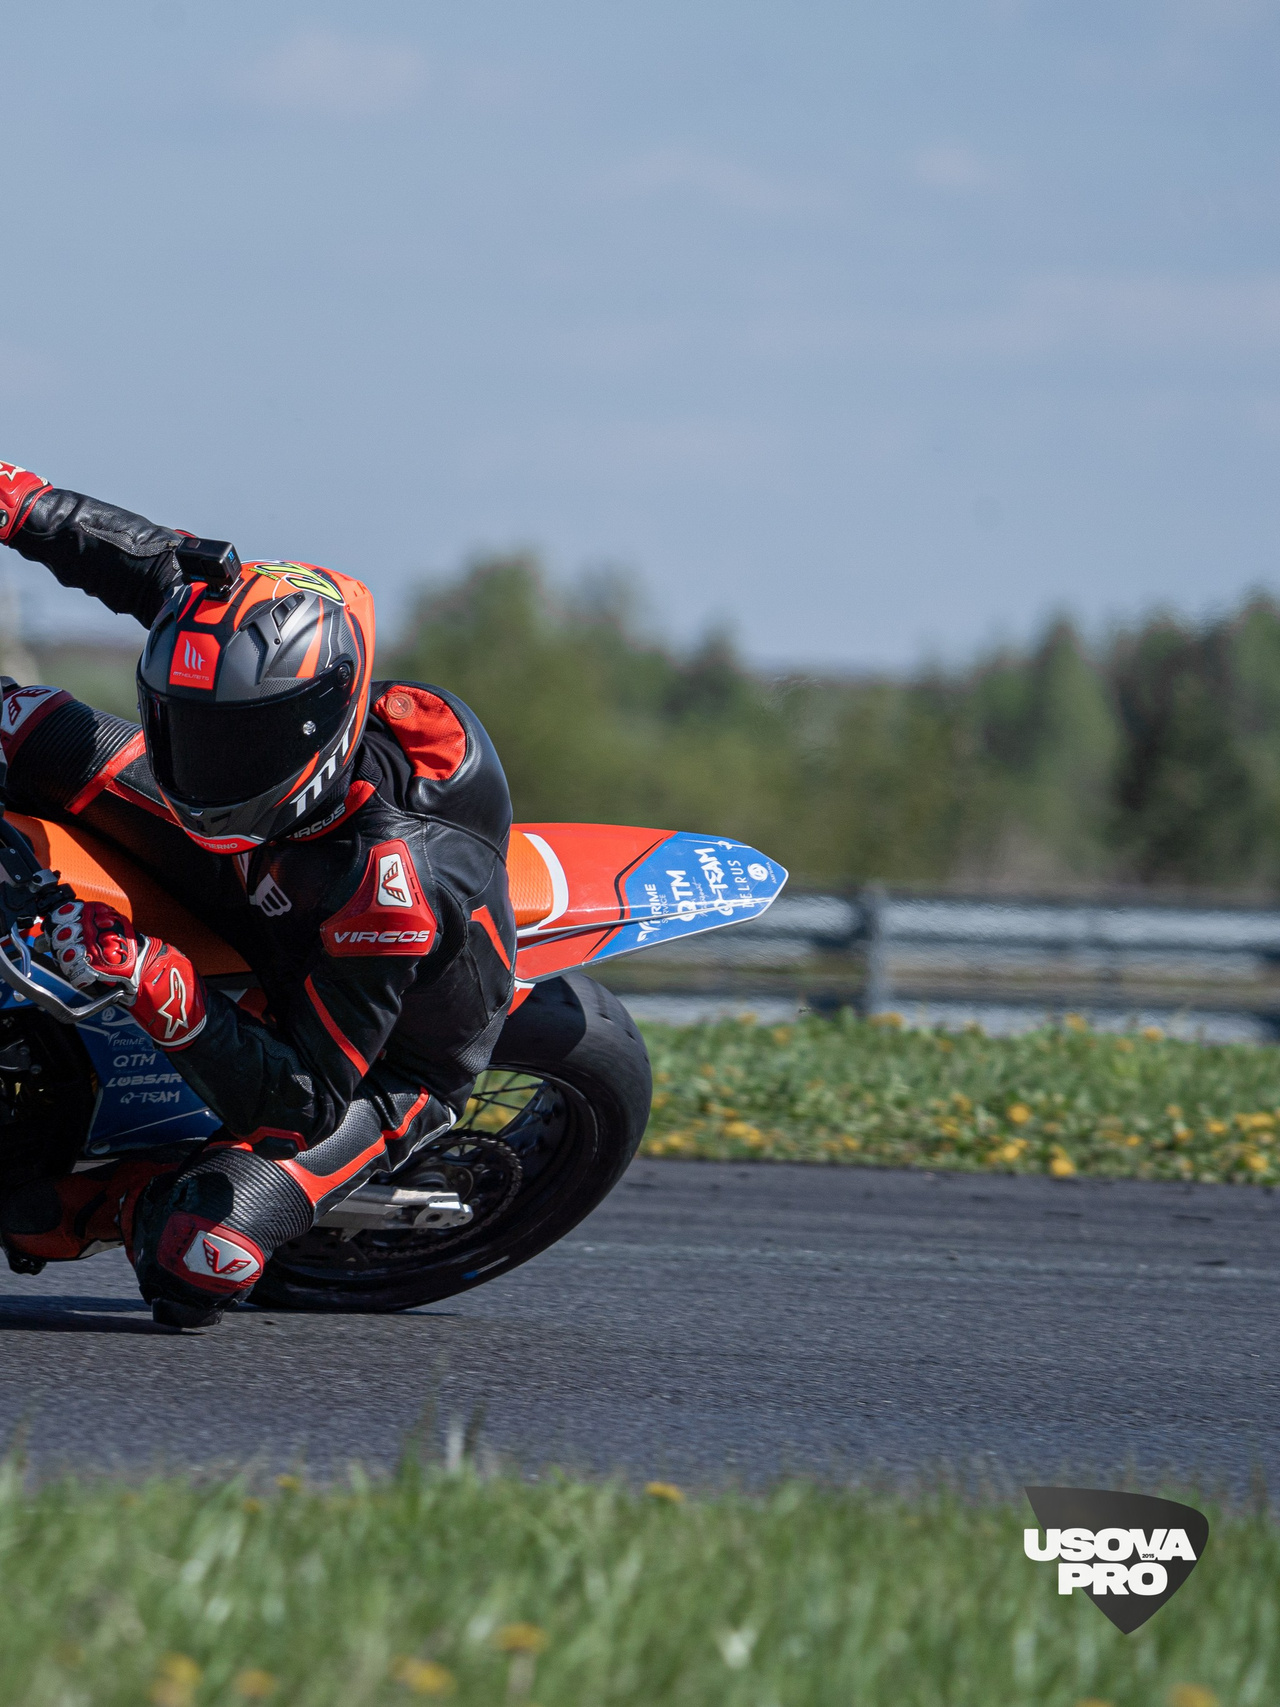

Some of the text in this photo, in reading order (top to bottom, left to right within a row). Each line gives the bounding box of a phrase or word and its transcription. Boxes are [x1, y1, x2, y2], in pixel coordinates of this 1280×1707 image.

[287, 803, 346, 840] IRCOS
[693, 847, 734, 916] Q-TEAM
[665, 870, 697, 922] QTM
[334, 929, 430, 943] VIRCOS
[113, 1037, 145, 1047] PRIME
[113, 1053, 157, 1068] QTM
[120, 1090, 181, 1104] Q-TEAM
